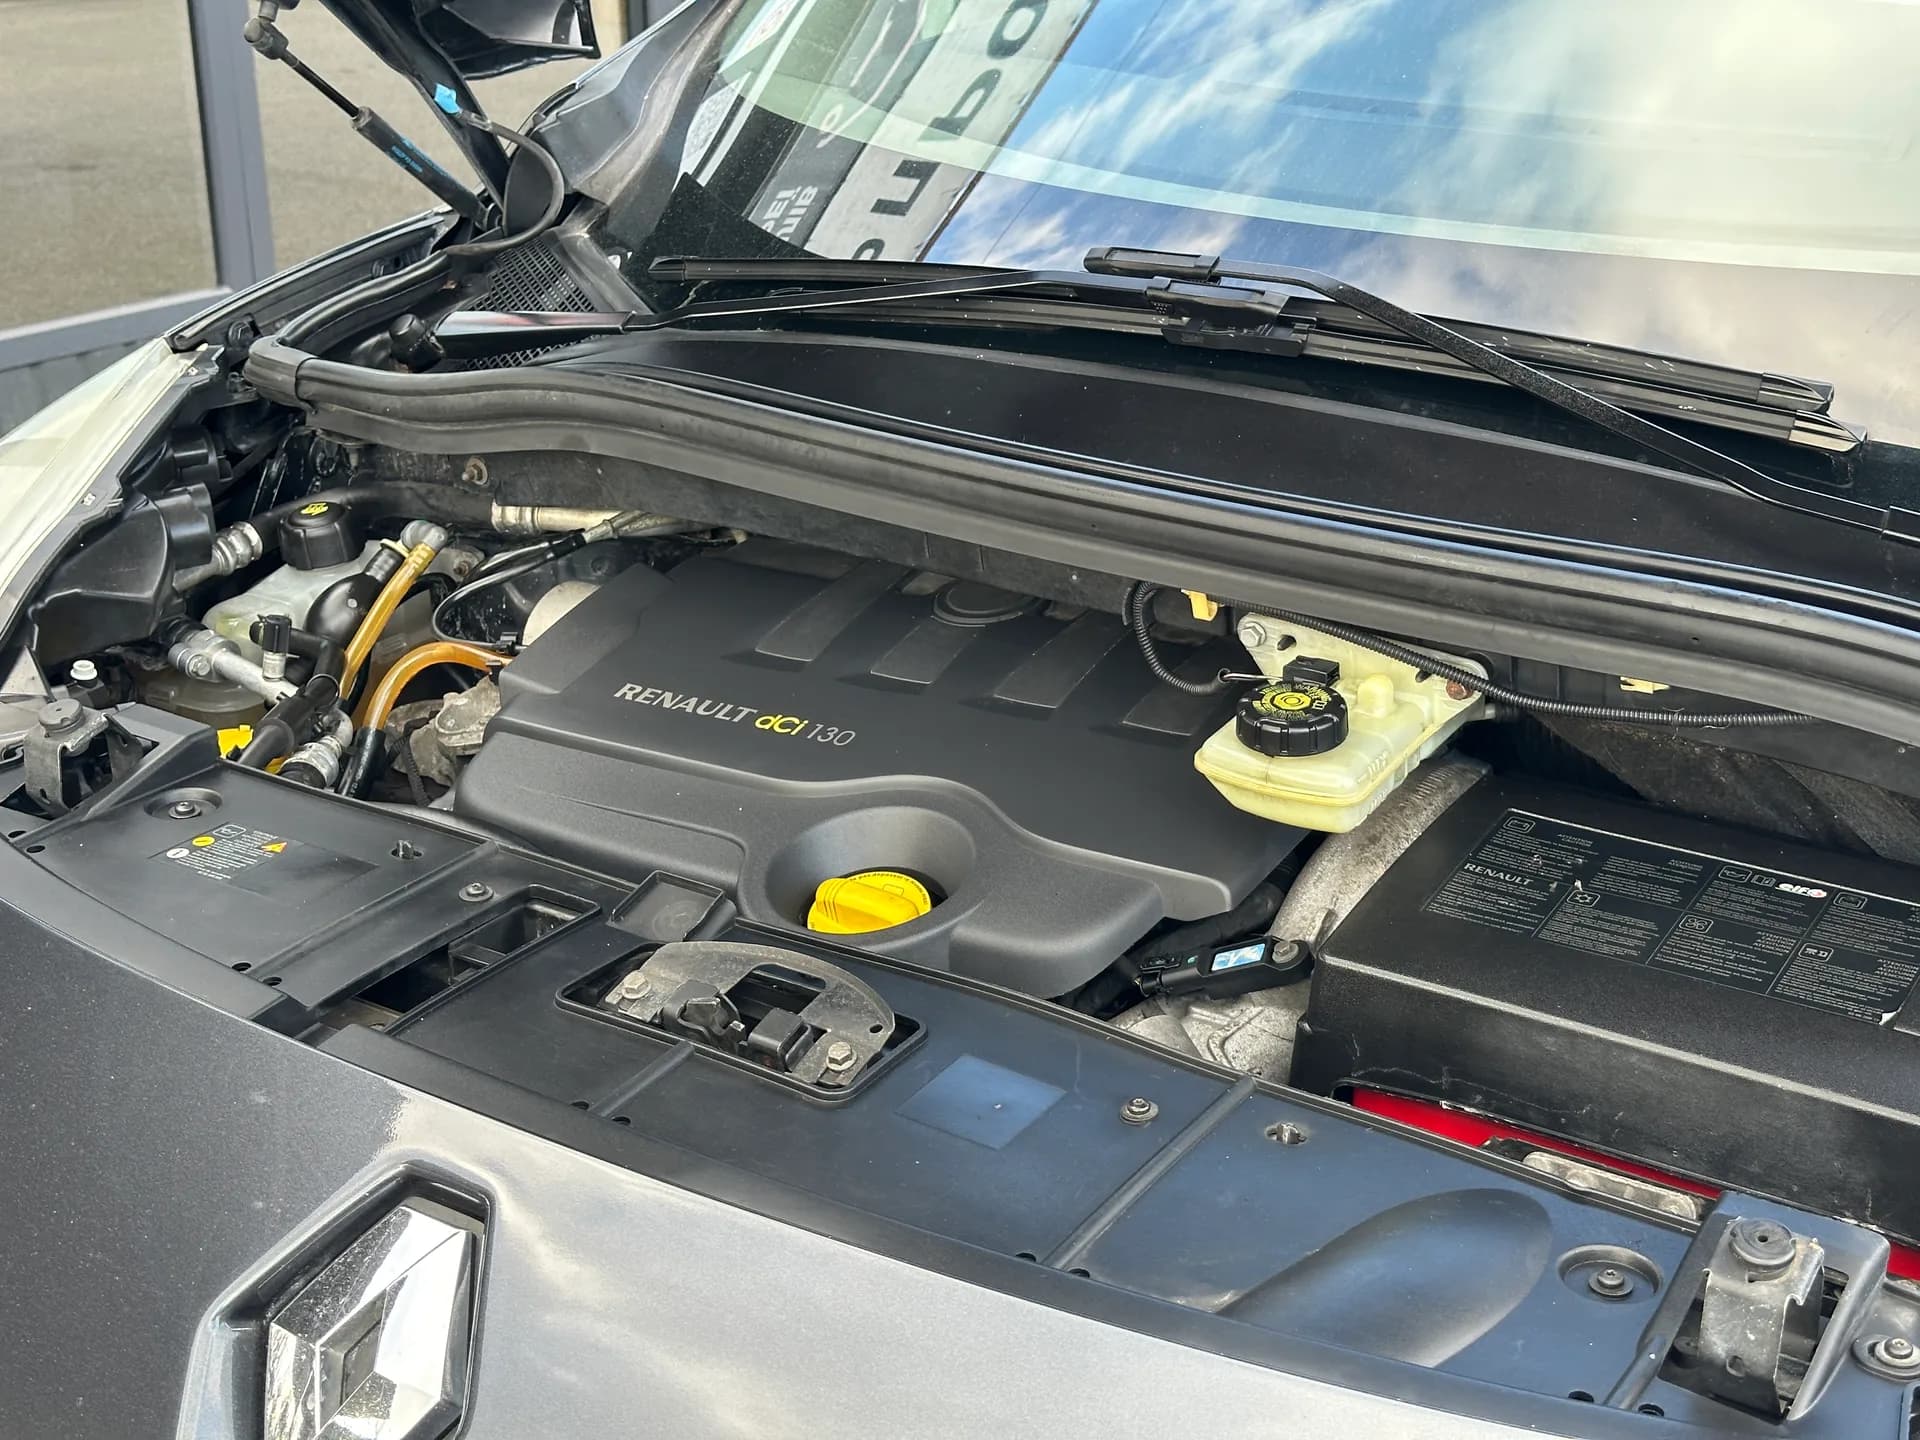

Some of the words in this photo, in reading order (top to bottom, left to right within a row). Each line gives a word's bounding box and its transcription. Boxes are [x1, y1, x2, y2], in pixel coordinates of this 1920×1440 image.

[614, 682, 757, 723] RENAULT
[754, 713, 808, 736] dCi
[807, 723, 856, 747] 130
[1464, 862, 1534, 886] RENAULT
